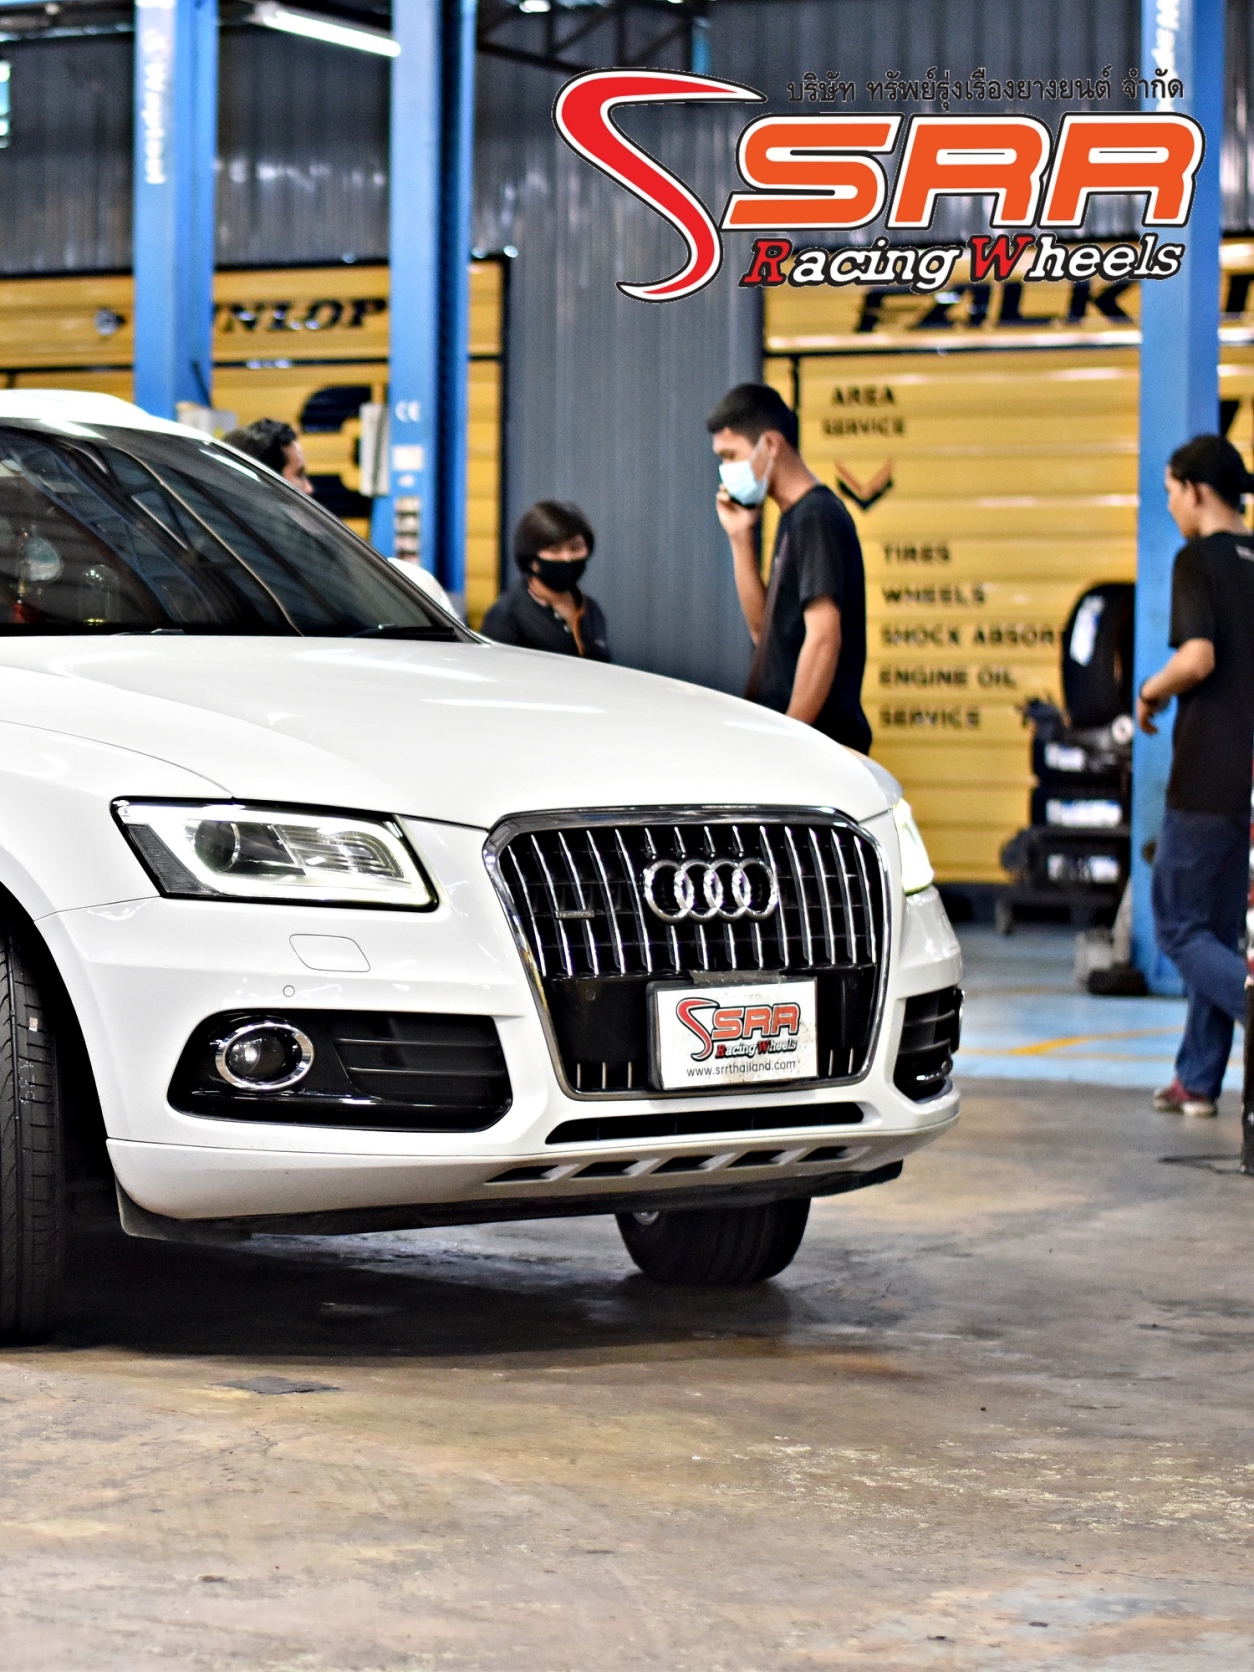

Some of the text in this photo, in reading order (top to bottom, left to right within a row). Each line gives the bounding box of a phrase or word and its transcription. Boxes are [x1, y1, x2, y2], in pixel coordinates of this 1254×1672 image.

[213, 298, 388, 333] NLOP
[831, 385, 896, 407] AREA
[823, 418, 906, 437] SERVICE
[883, 544, 951, 563] TIRES
[882, 585, 986, 605] WHEELS
[881, 625, 1055, 646] SHOCK ABSOR
[879, 667, 1017, 688] ENGINE OIL
[879, 707, 981, 728] SERVICE
[715, 1038, 797, 1059] Racing Wheels
[686, 1060, 797, 1077] www.srrthailand.com
